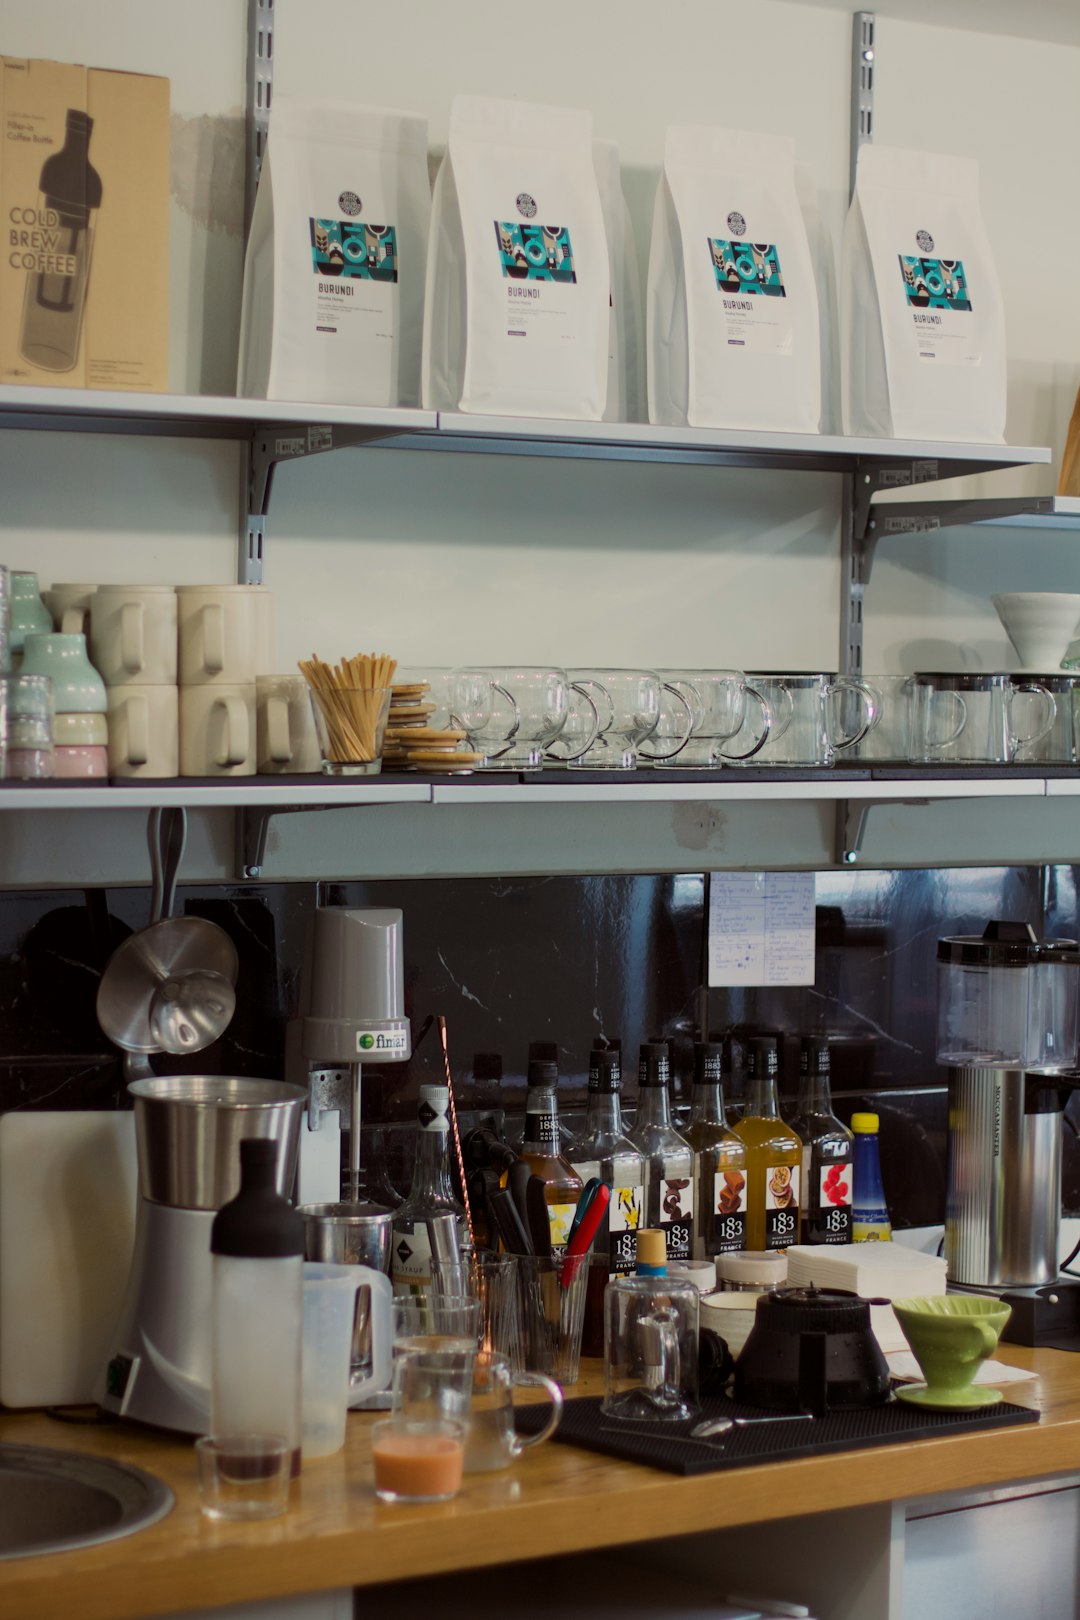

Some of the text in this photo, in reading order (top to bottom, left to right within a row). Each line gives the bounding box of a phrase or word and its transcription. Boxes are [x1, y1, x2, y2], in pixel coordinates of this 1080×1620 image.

[9, 207, 58, 227] COLD
[10, 229, 59, 249] BREW
[9, 251, 74, 274] COFFEE
[318, 282, 354, 296] BURUNDI
[507, 286, 540, 299] BURUNDI
[722, 299, 753, 311] BURUNDI
[913, 314, 942, 325] BURUNDI
[704, 1062, 721, 1070] 1883
[401, 1265, 424, 1273] SYRUP
